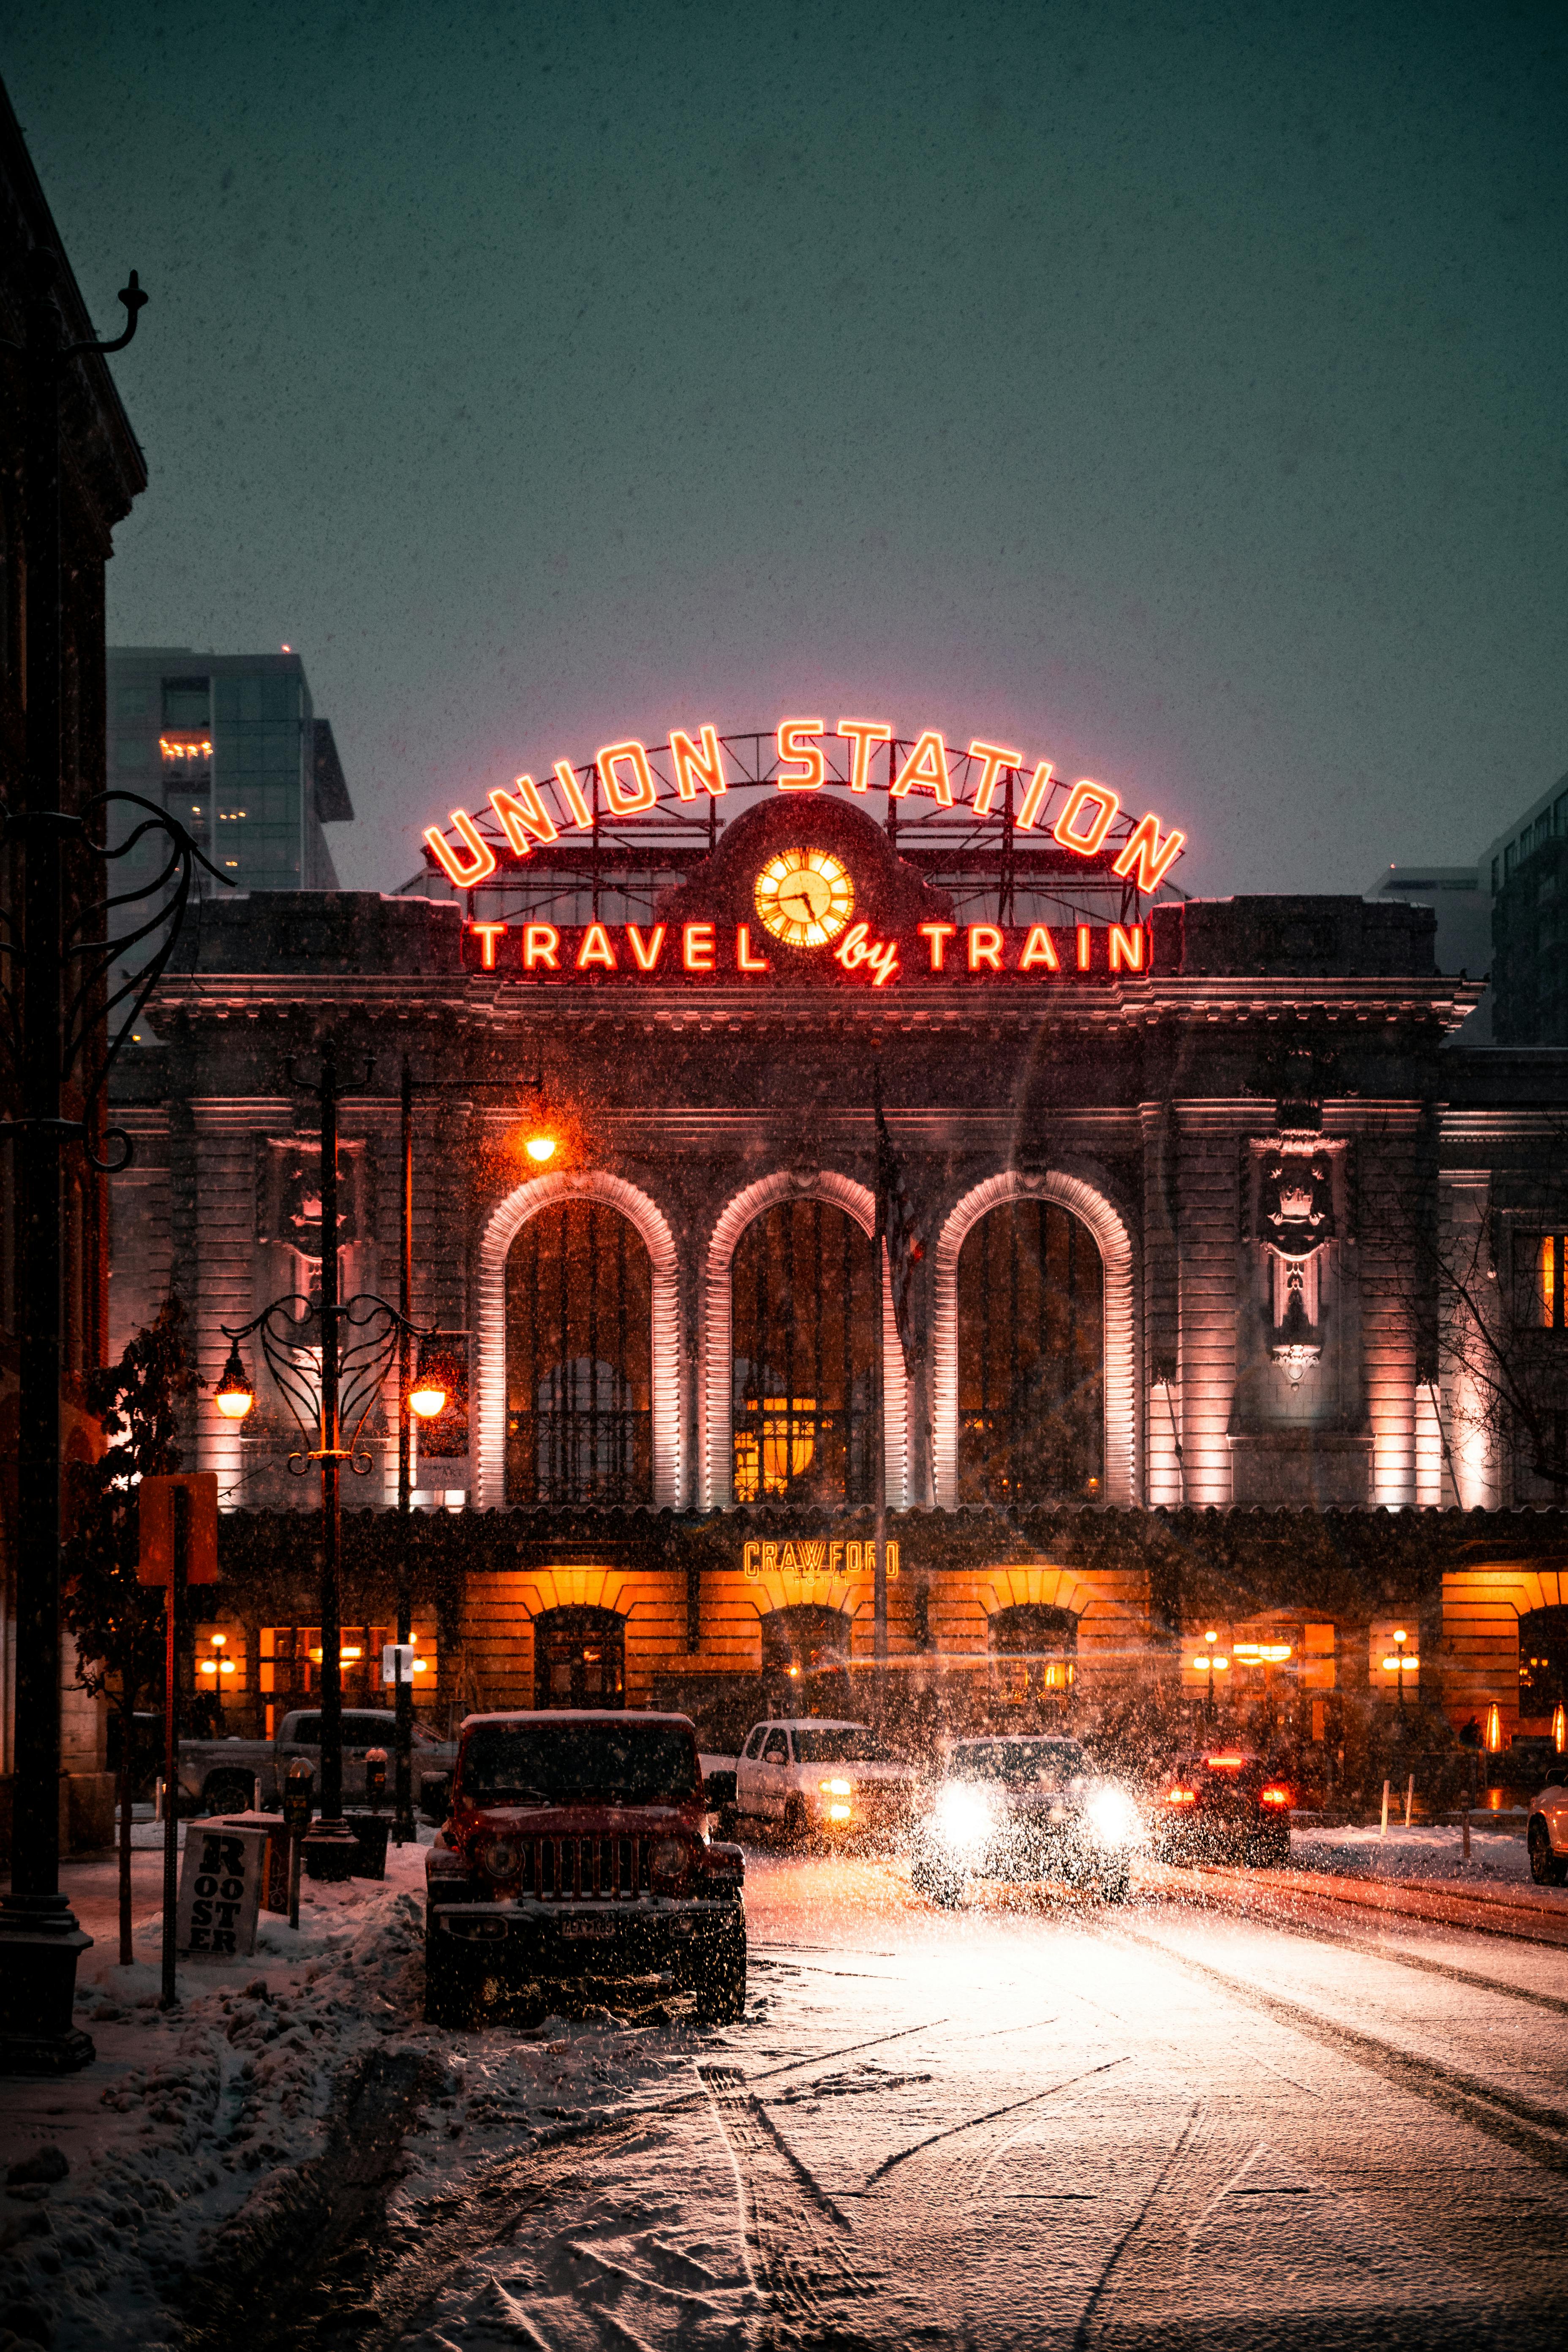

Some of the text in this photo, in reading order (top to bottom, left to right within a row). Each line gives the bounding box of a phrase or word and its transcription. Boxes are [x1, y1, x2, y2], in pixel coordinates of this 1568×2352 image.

[423, 717, 1187, 895] UNION STATION
[471, 922, 1143, 986] TRAVEL by TRAIN
[744, 1541, 899, 1579] CRAWFORD
[793, 1575, 852, 1586] HOTEL
